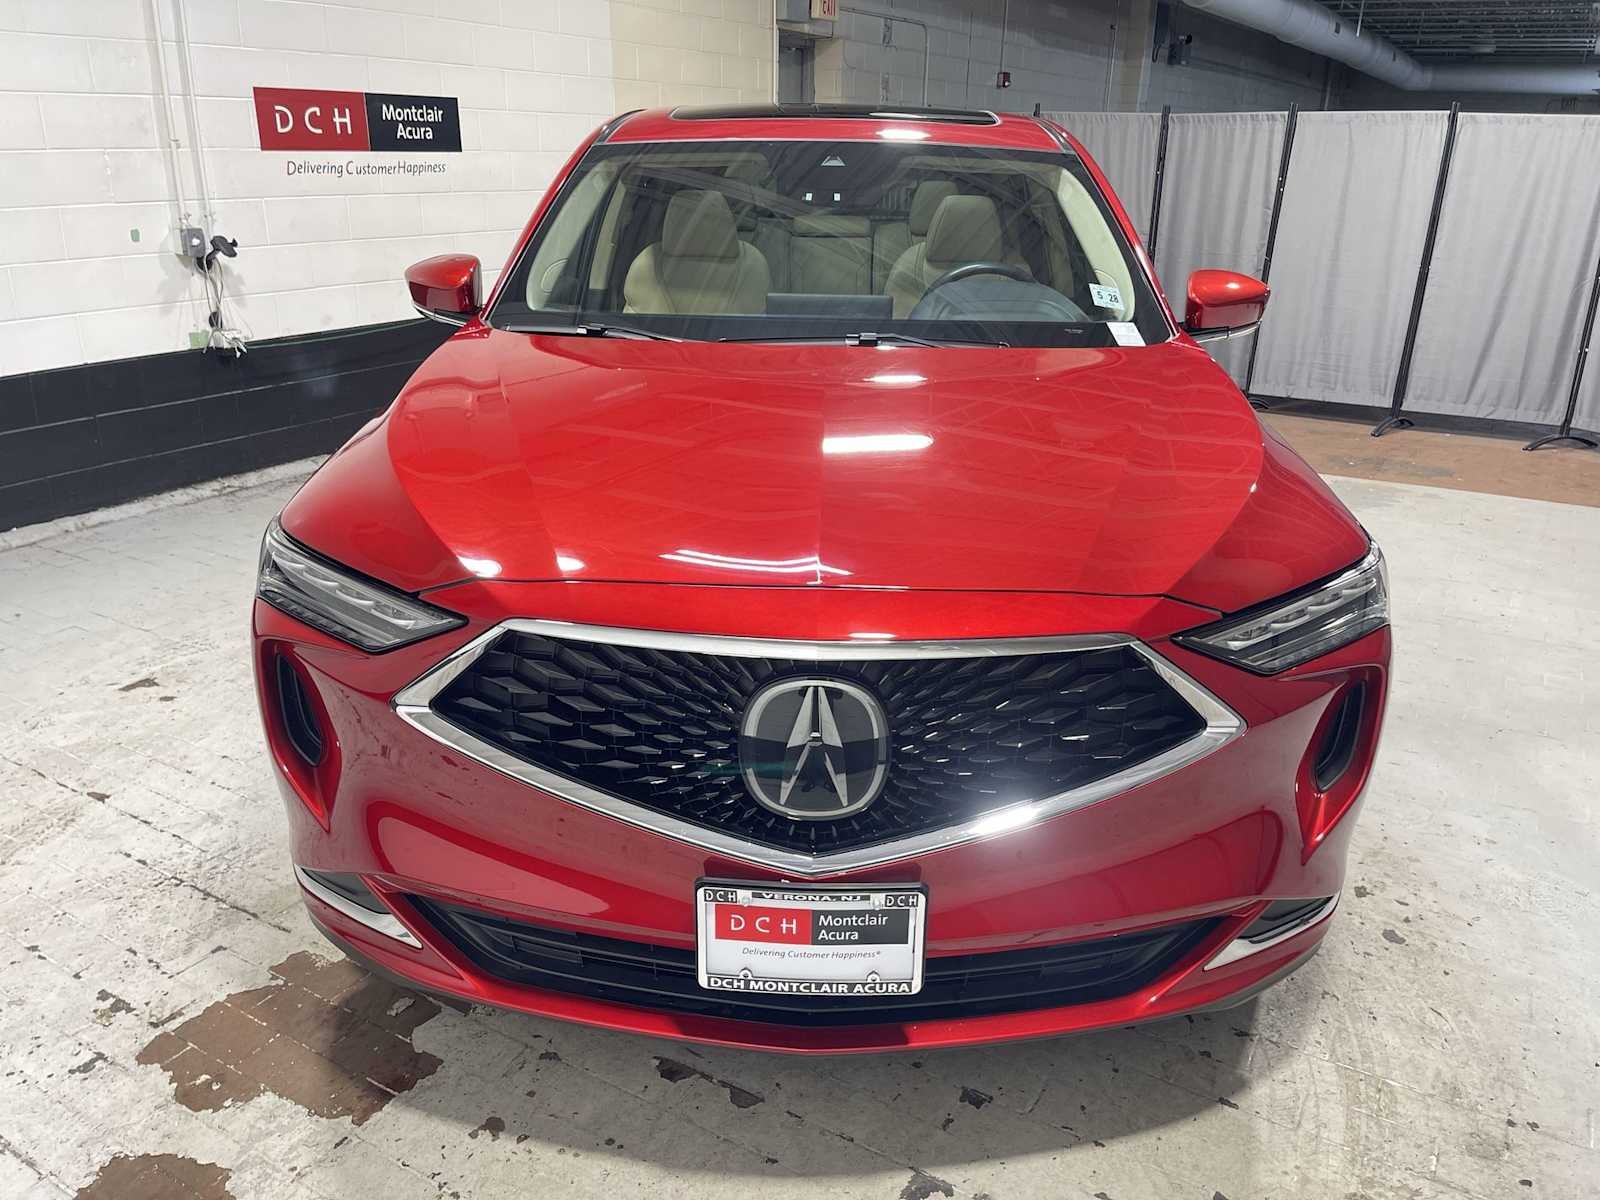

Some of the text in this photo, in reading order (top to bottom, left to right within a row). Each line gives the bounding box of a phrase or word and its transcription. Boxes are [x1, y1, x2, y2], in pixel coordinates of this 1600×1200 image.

[274, 105, 352, 135] DCH
[382, 103, 444, 123] Montclair
[396, 123, 434, 140] Acura
[286, 160, 446, 178] Delivering Customer Happiness
[705, 890, 737, 902] DCH
[841, 894, 861, 902] NJ
[887, 895, 918, 906] DCH
[730, 914, 797, 935] DCH
[818, 914, 889, 927] Montclair
[817, 929, 859, 941] Acura
[742, 947, 786, 959] Delivering
[787, 949, 829, 959] Customer
[709, 977, 911, 994] DCH MONTCLAIR ACURA
